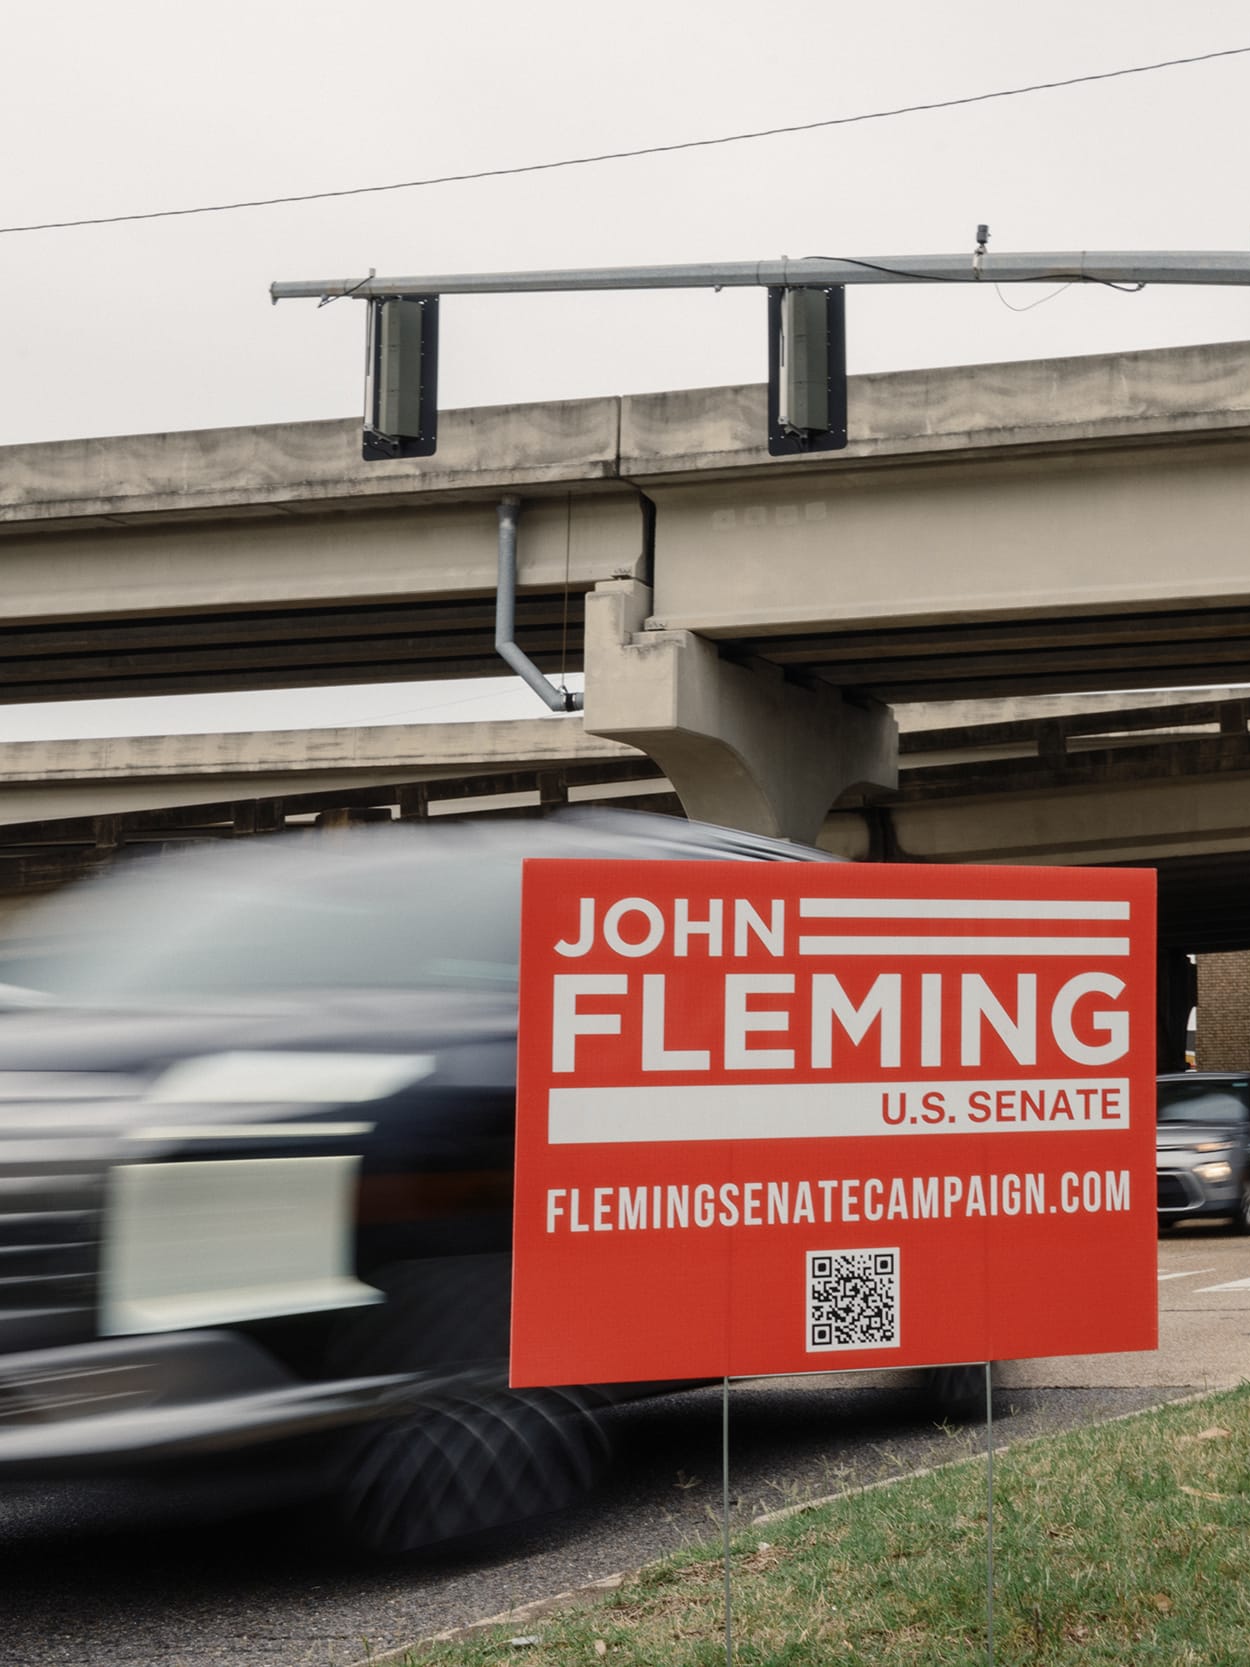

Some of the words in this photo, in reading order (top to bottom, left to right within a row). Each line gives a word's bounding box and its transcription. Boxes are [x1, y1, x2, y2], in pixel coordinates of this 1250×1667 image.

[554, 898, 785, 958] JOHN
[552, 972, 1130, 1073] FLEMING
[882, 1091, 956, 1125] U.S.
[968, 1088, 1121, 1122] SENATE
[546, 1170, 1131, 1233] FLEMINGSENATECAMPAIGN.COM
